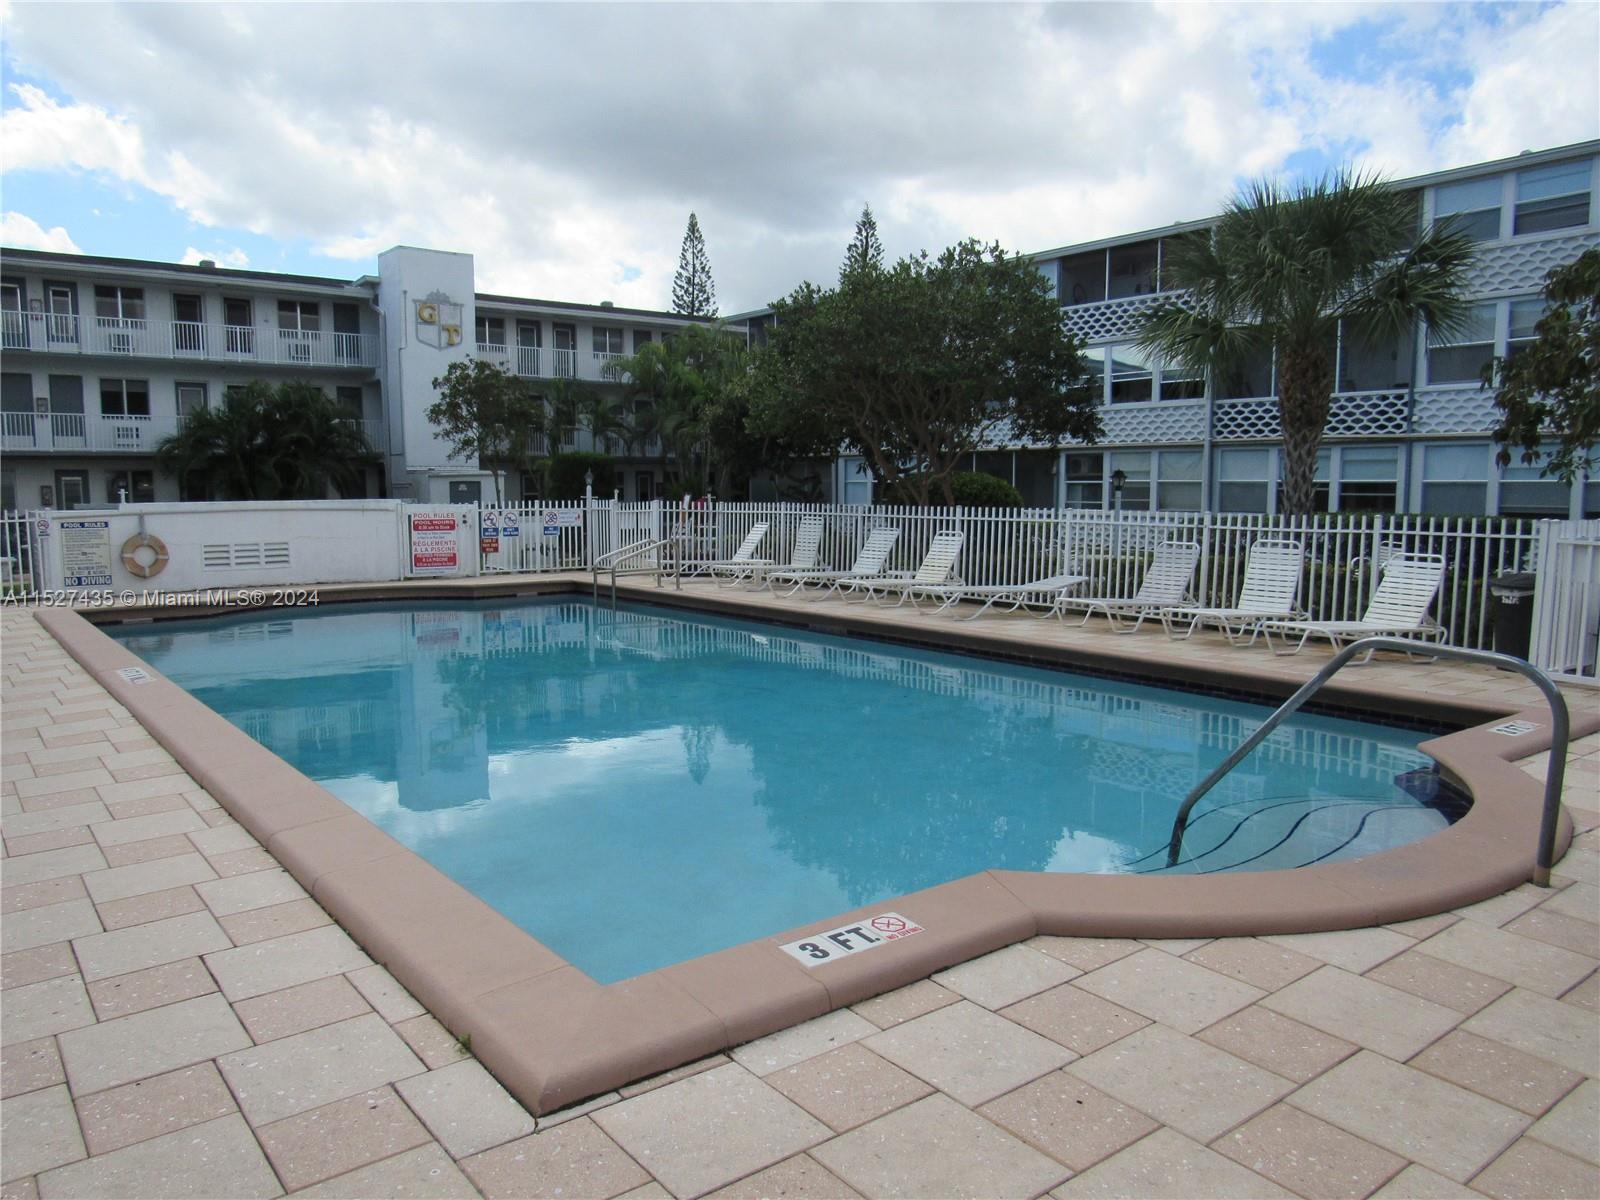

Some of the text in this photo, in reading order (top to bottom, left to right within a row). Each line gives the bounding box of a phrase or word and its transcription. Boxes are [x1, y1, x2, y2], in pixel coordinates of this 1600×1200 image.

[418, 303, 438, 324] G
[442, 324, 461, 346] T
[65, 575, 112, 586] NO DIVING
[798, 926, 881, 959] 3 FT.
